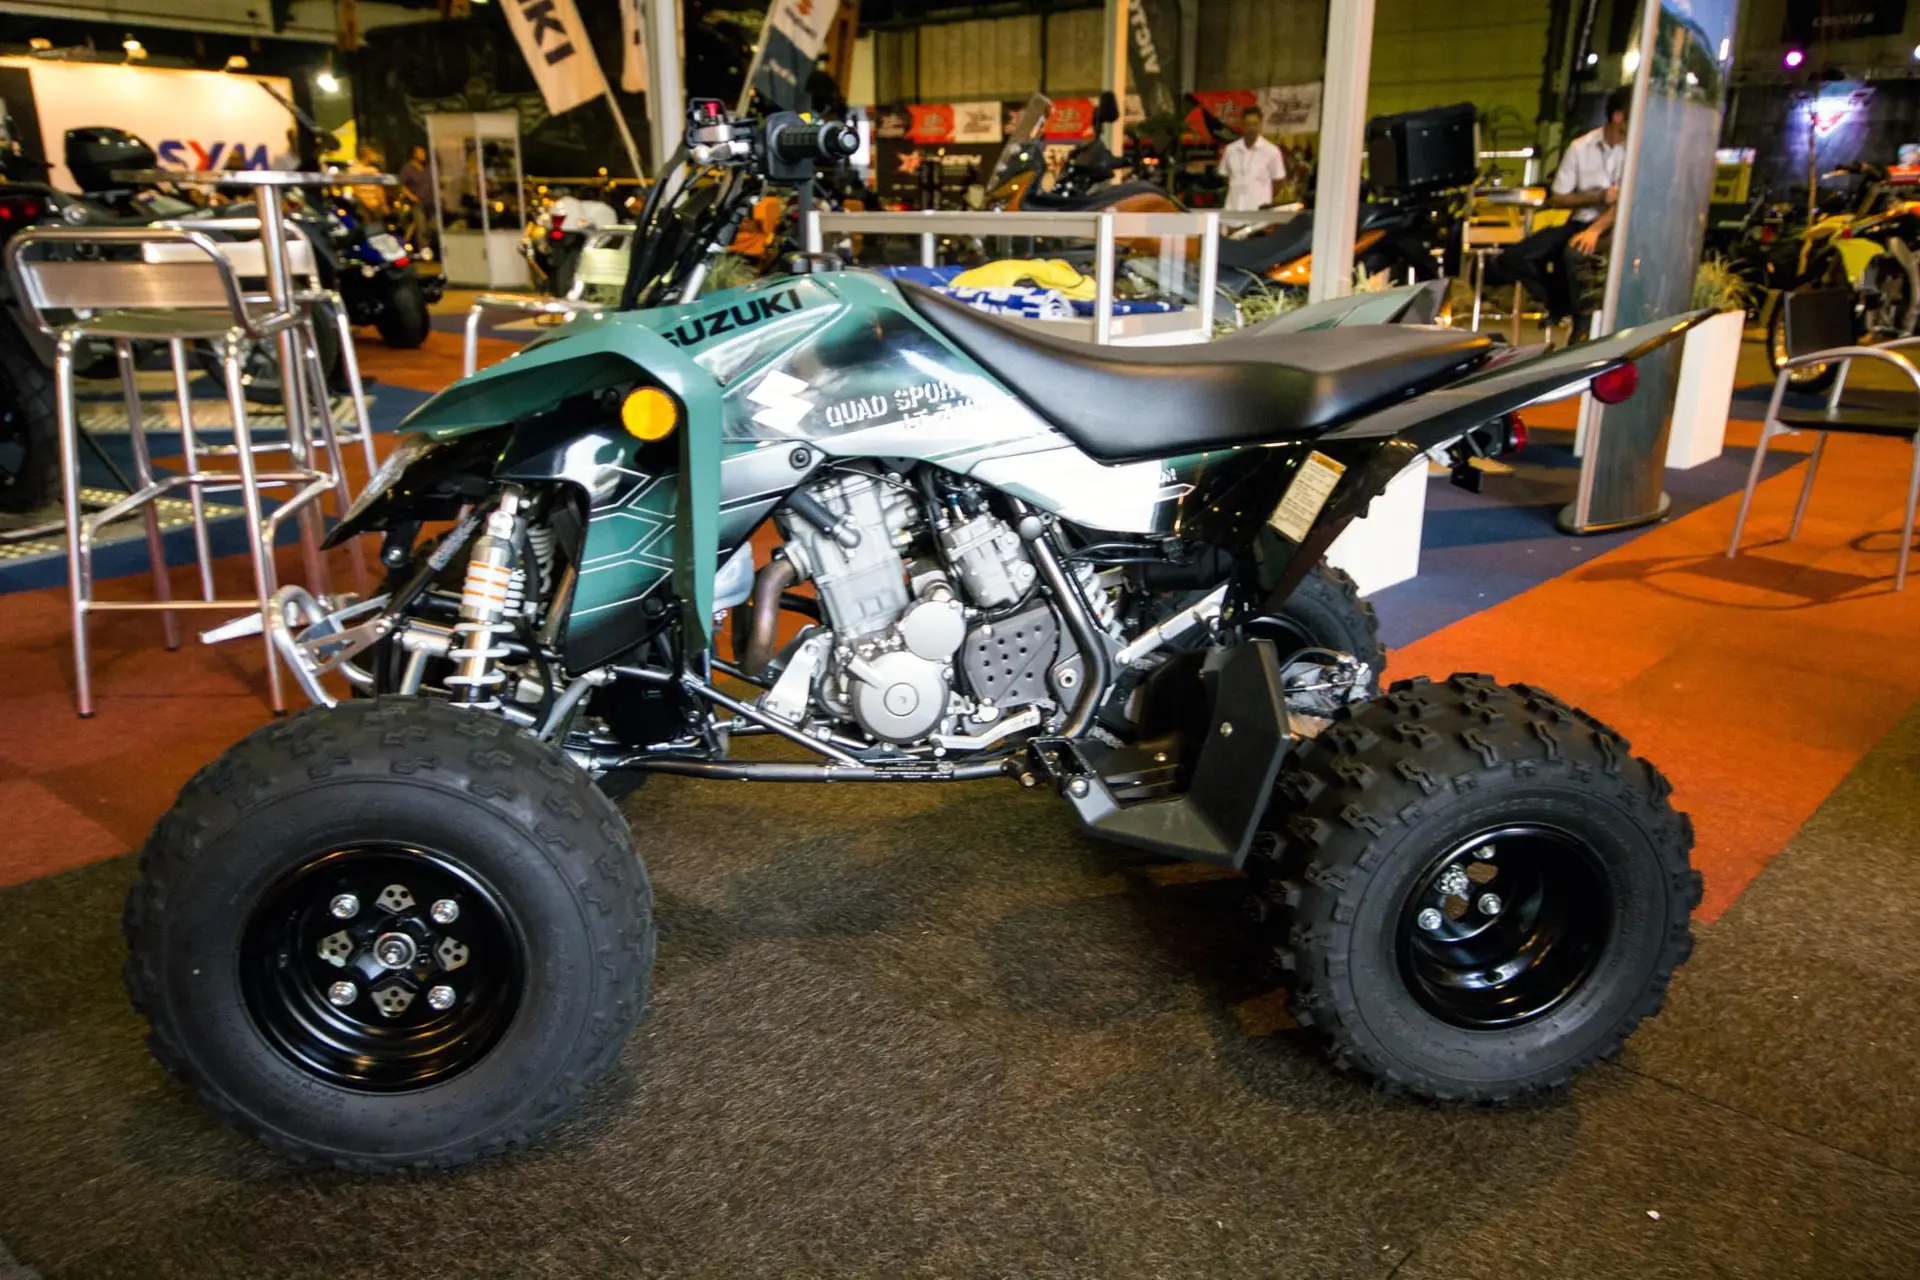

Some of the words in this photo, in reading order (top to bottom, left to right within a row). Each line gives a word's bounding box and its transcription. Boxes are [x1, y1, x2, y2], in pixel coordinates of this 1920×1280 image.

[519, 0, 576, 66] KI
[157, 140, 270, 172] SYM
[825, 395, 888, 428] QUAD
